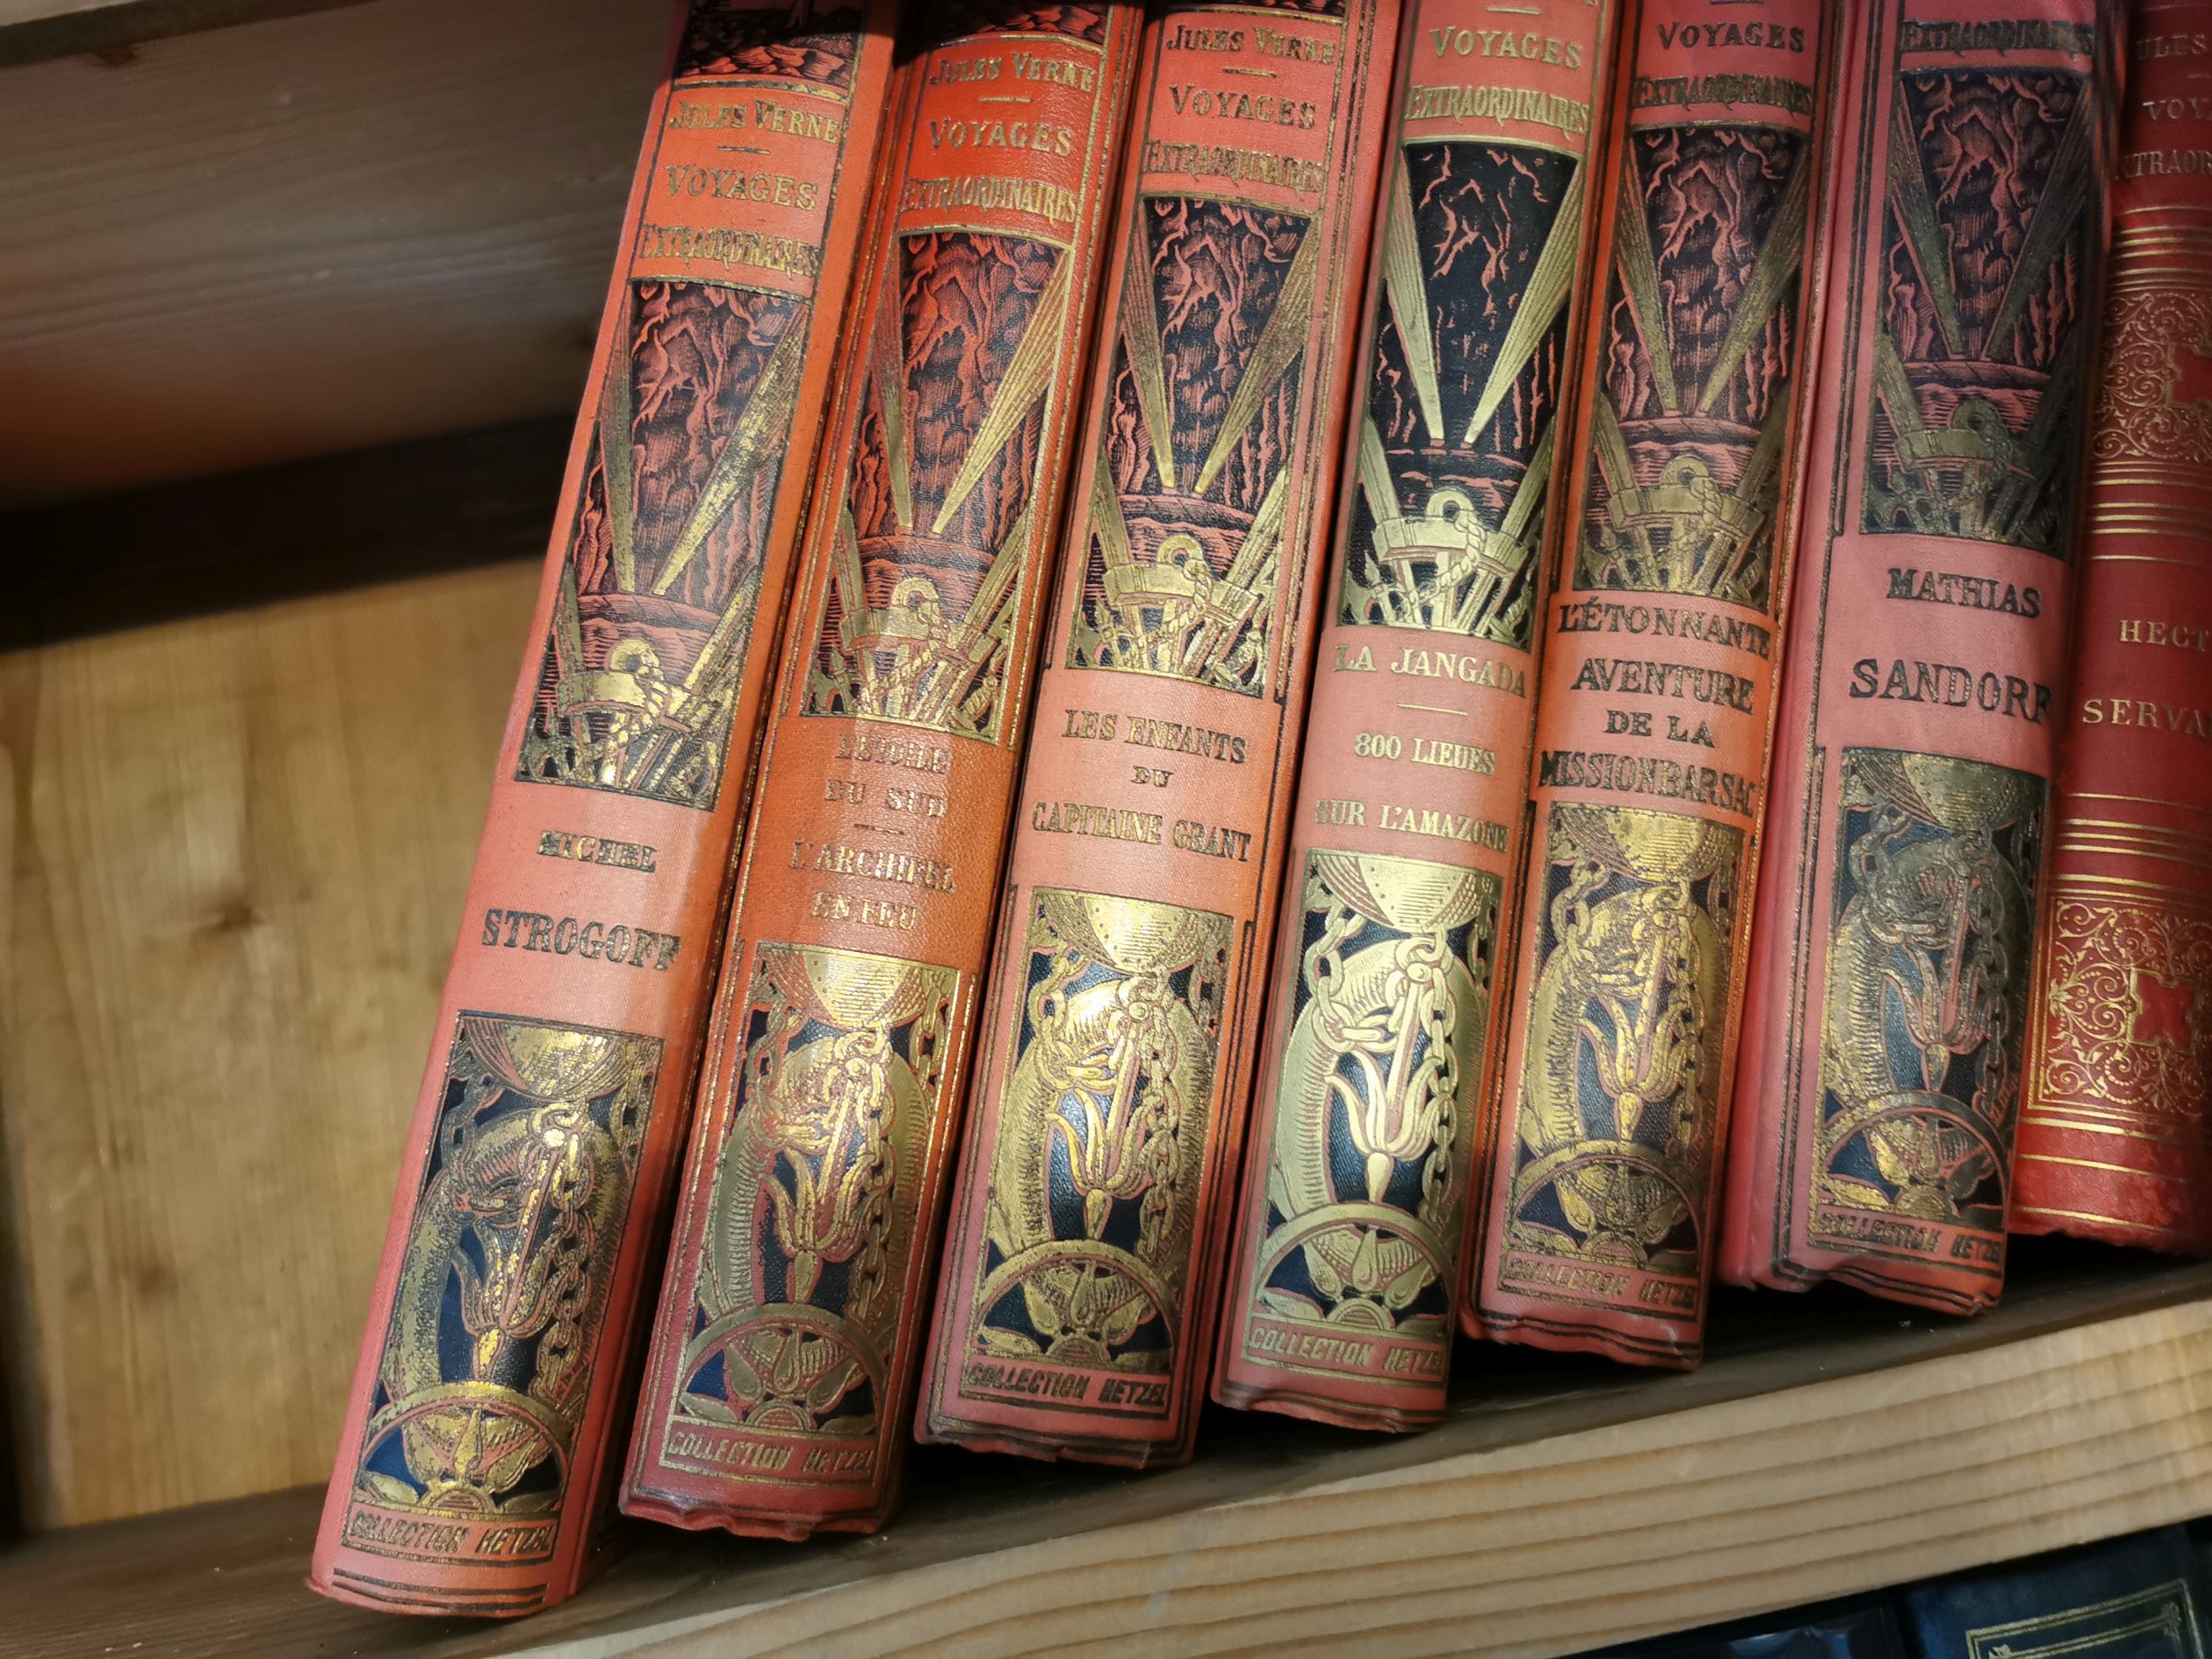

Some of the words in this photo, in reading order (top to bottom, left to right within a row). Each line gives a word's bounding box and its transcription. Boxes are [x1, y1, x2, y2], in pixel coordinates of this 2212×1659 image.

[1166, 24, 1245, 52] JULES
[1253, 27, 1336, 65] VERNE
[1428, 26, 1583, 69] VOYAGES
[1656, 21, 1805, 53] VOYAGES
[929, 58, 1002, 86] JULES
[1011, 50, 1097, 93] VERNE
[669, 100, 748, 130] JULES
[755, 99, 842, 144] VERNE
[1169, 84, 1317, 130] VOYAGES
[929, 118, 1076, 157] VOYAGES
[664, 163, 818, 211] VOYAGES
[1886, 568, 2041, 618] MATHIAS
[1557, 595, 1770, 660] L'ÉTONNANTE
[1333, 644, 1377, 672] LA
[1391, 647, 1527, 699] JANGADA
[1571, 658, 1755, 715] AVENTURE
[1062, 709, 1118, 741] LES
[1125, 715, 1248, 764] ENFANTS
[1604, 710, 1652, 737] DE
[1667, 715, 1716, 749] LA
[1132, 765, 1174, 787] DU
[1355, 733, 1402, 760] 800
[1410, 738, 1495, 776] LIEUES
[1538, 750, 1657, 794] MISSION
[824, 779, 865, 803] DU
[886, 787, 949, 818] SUD
[1032, 802, 1163, 844] CAPITAINE
[1172, 819, 1252, 862] GRANT
[1315, 798, 1366, 826] SUR
[1379, 803, 1509, 854] L'AMAZONE
[537, 830, 657, 872] MICHEL
[788, 841, 956, 893] L'ARCHIPEL
[810, 891, 853, 919] EN
[857, 897, 918, 930] FEU
[481, 908, 680, 971] STROGOFF
[1248, 1327, 1374, 1367] COLLECTION
[966, 1363, 1091, 1400] COLLECTION
[1098, 1378, 1168, 1408] HETZEL
[667, 1431, 793, 1471] COLLECTION
